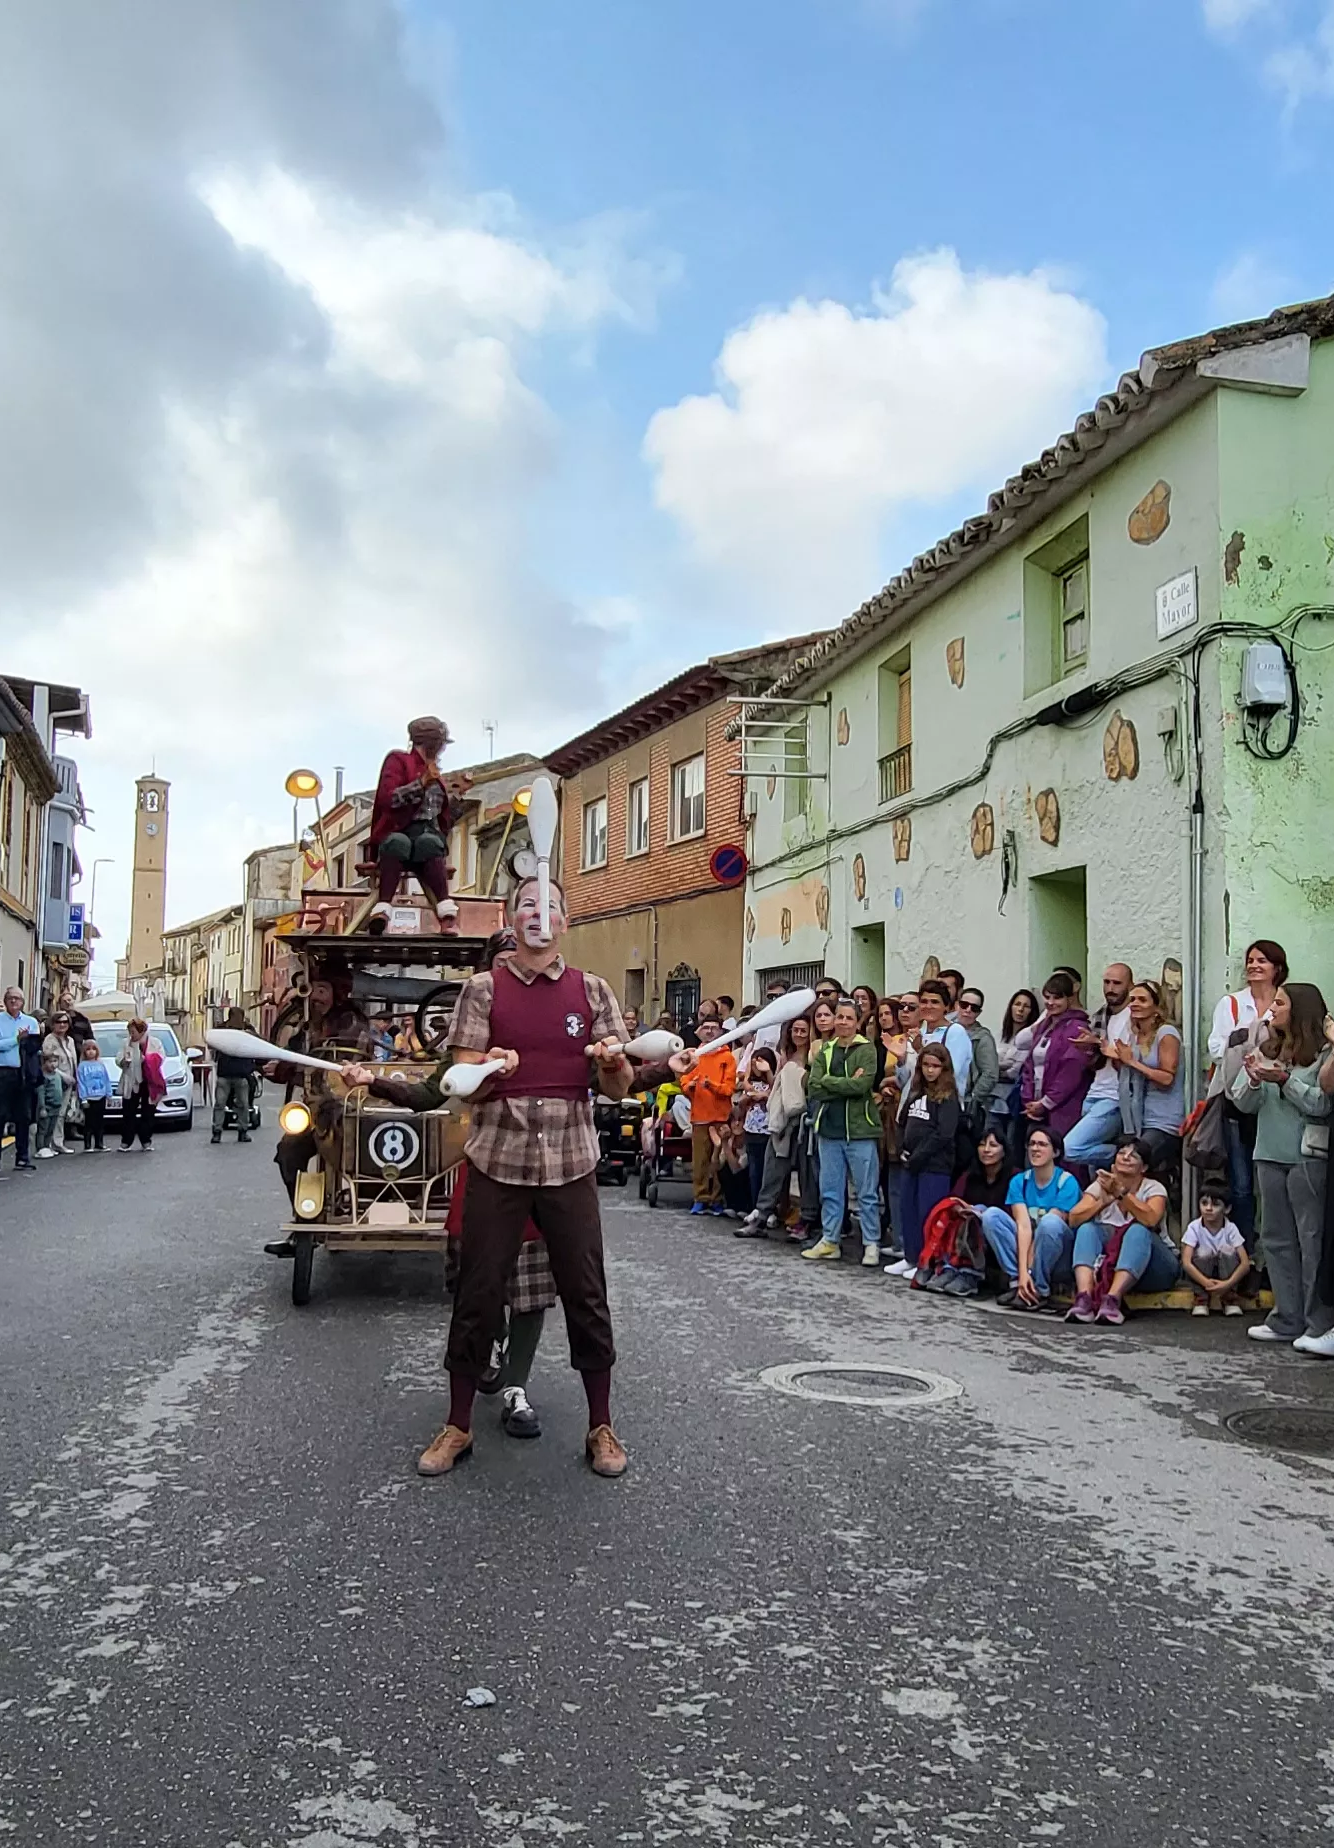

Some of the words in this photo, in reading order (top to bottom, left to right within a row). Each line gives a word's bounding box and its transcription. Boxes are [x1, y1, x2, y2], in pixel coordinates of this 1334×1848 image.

[1170, 582, 1190, 600] Calle
[1162, 602, 1192, 625] Mayor
[567, 1015, 579, 1034] 3
[382, 1129, 405, 1162] 8
